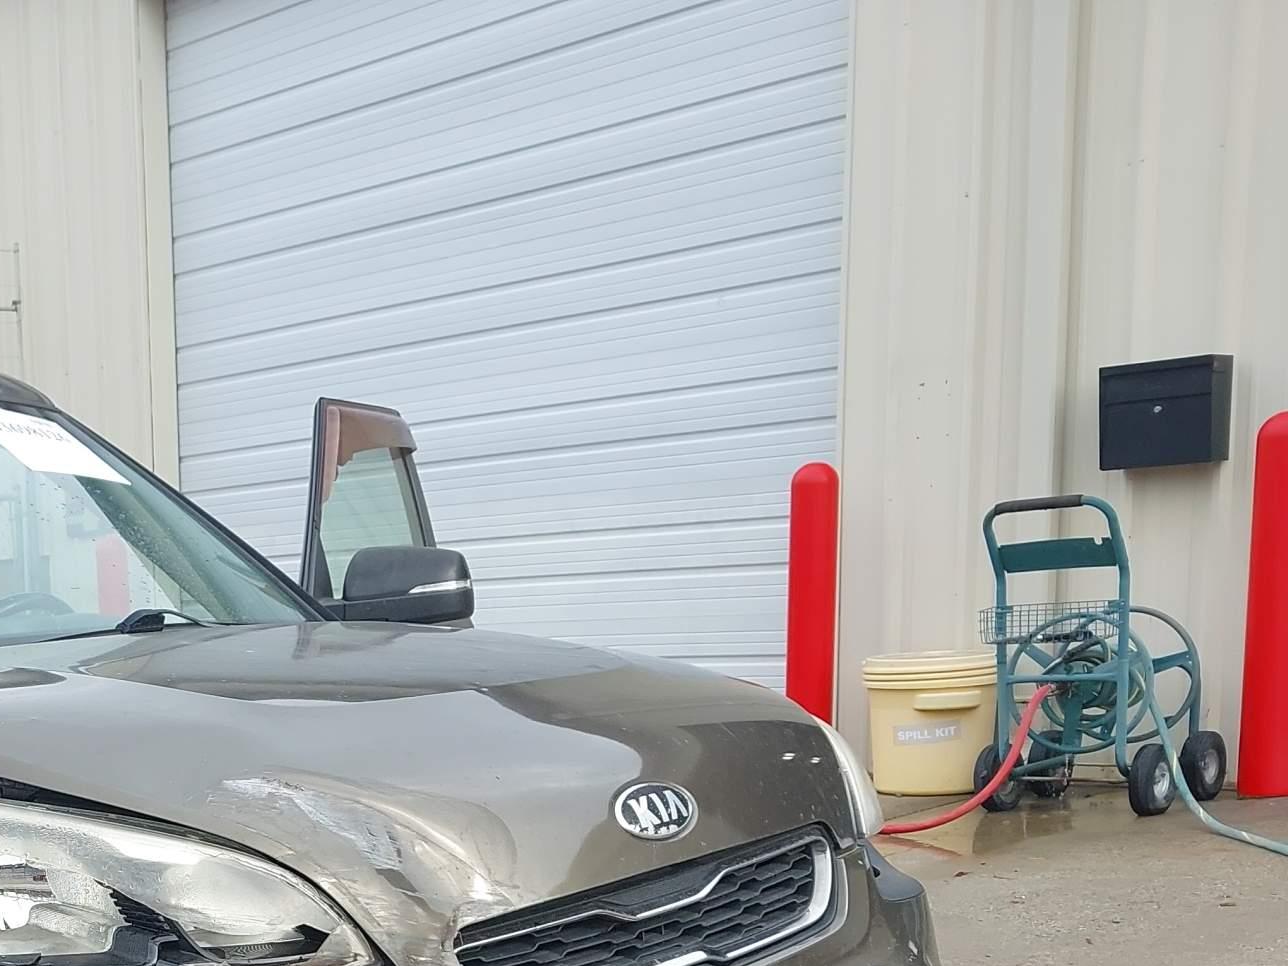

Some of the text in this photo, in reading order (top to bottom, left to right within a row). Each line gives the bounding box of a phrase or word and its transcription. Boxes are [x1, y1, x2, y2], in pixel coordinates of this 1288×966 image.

[896, 725, 958, 742] SPILL KIT
[626, 789, 689, 829] KIA
